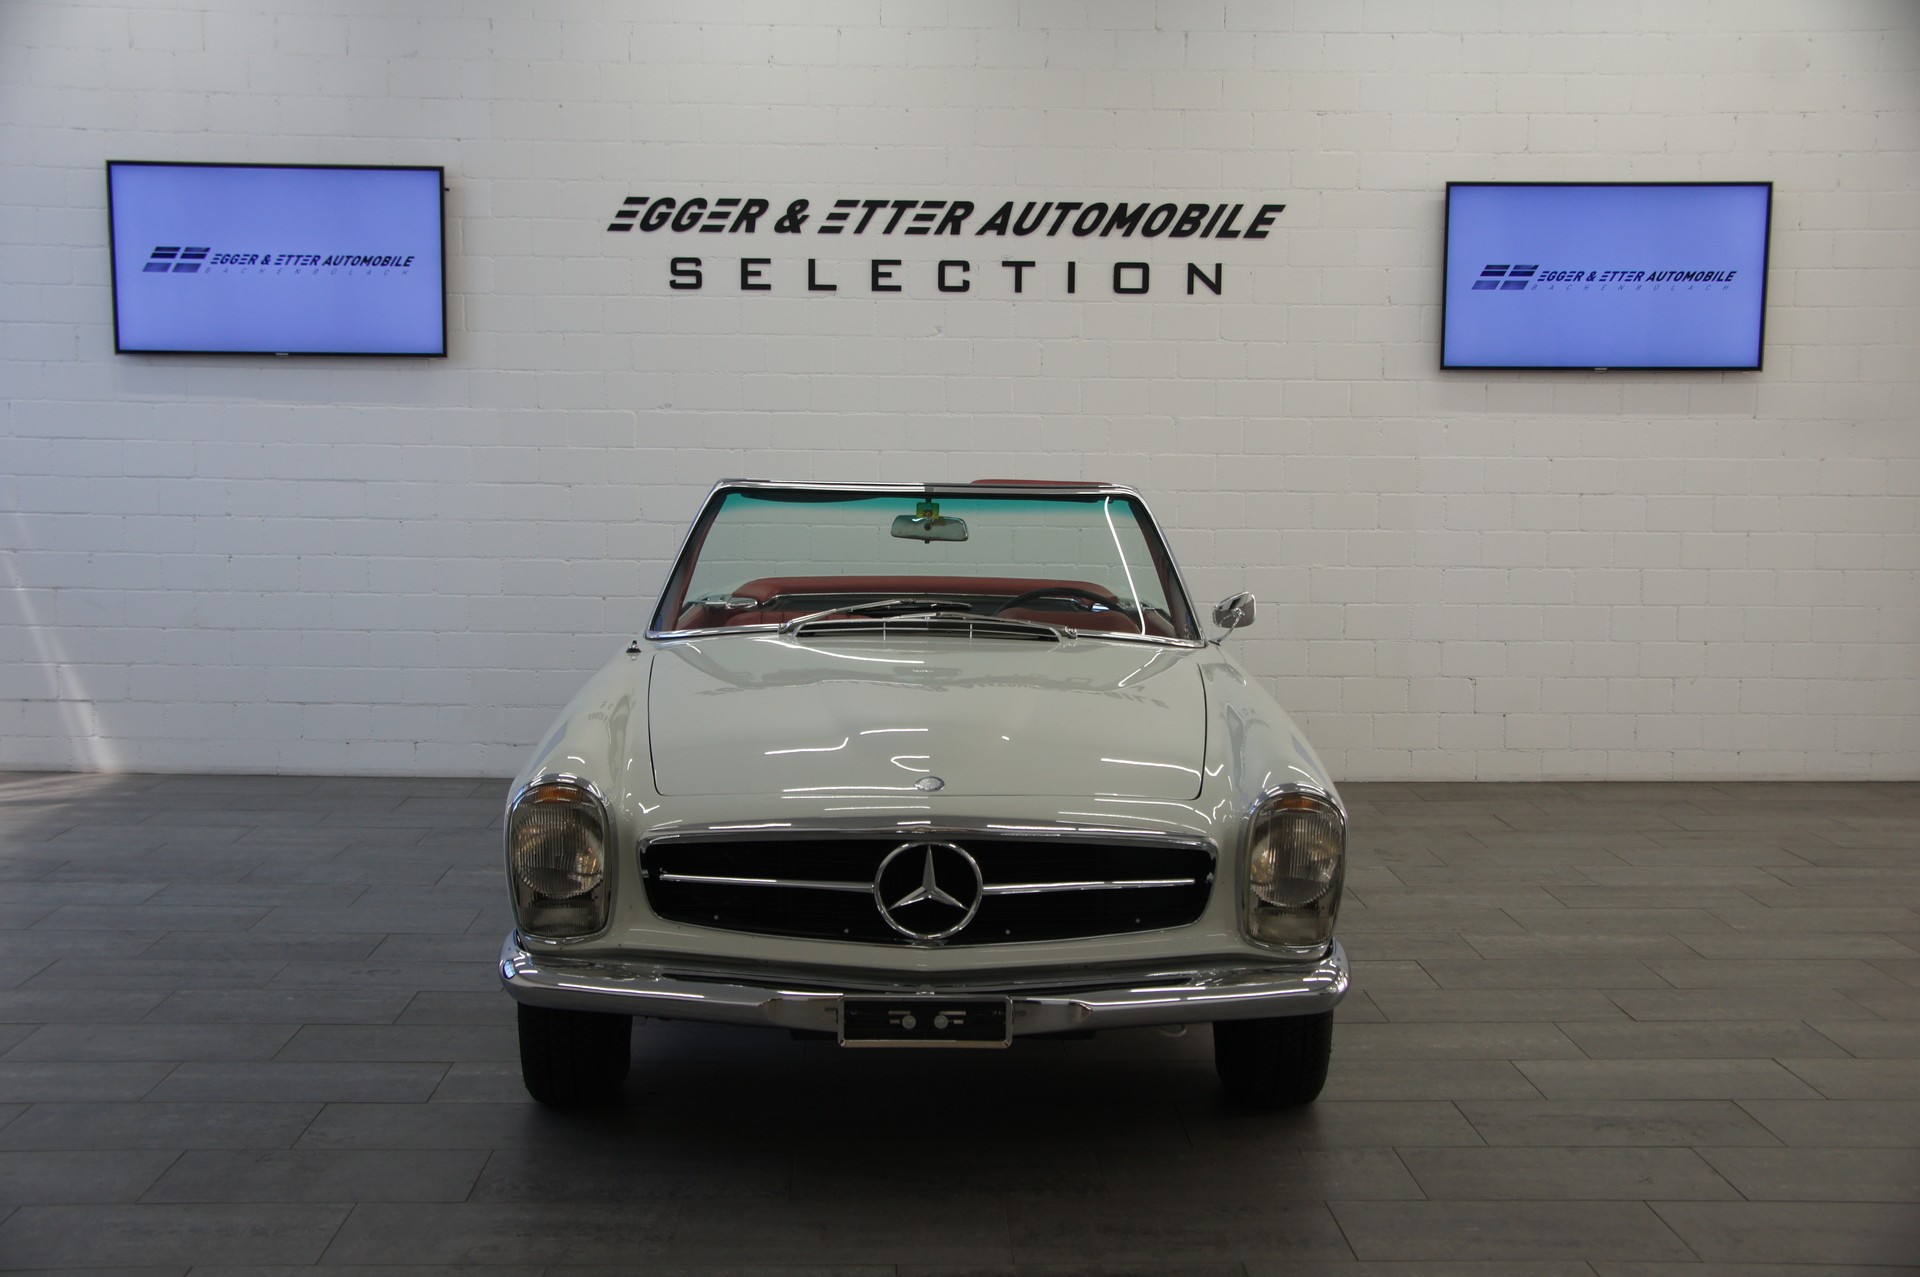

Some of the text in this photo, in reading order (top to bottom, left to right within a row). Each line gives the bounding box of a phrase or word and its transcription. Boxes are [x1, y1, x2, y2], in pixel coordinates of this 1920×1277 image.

[607, 196, 1287, 239] EGGER & ETTER AUTOMOBILE
[210, 253, 414, 267] EGGER & ETTER AUTOMOBILE
[669, 256, 1224, 296] SELECTION
[1537, 270, 1737, 282] EGGER & ETTER AUTOMOBILE
